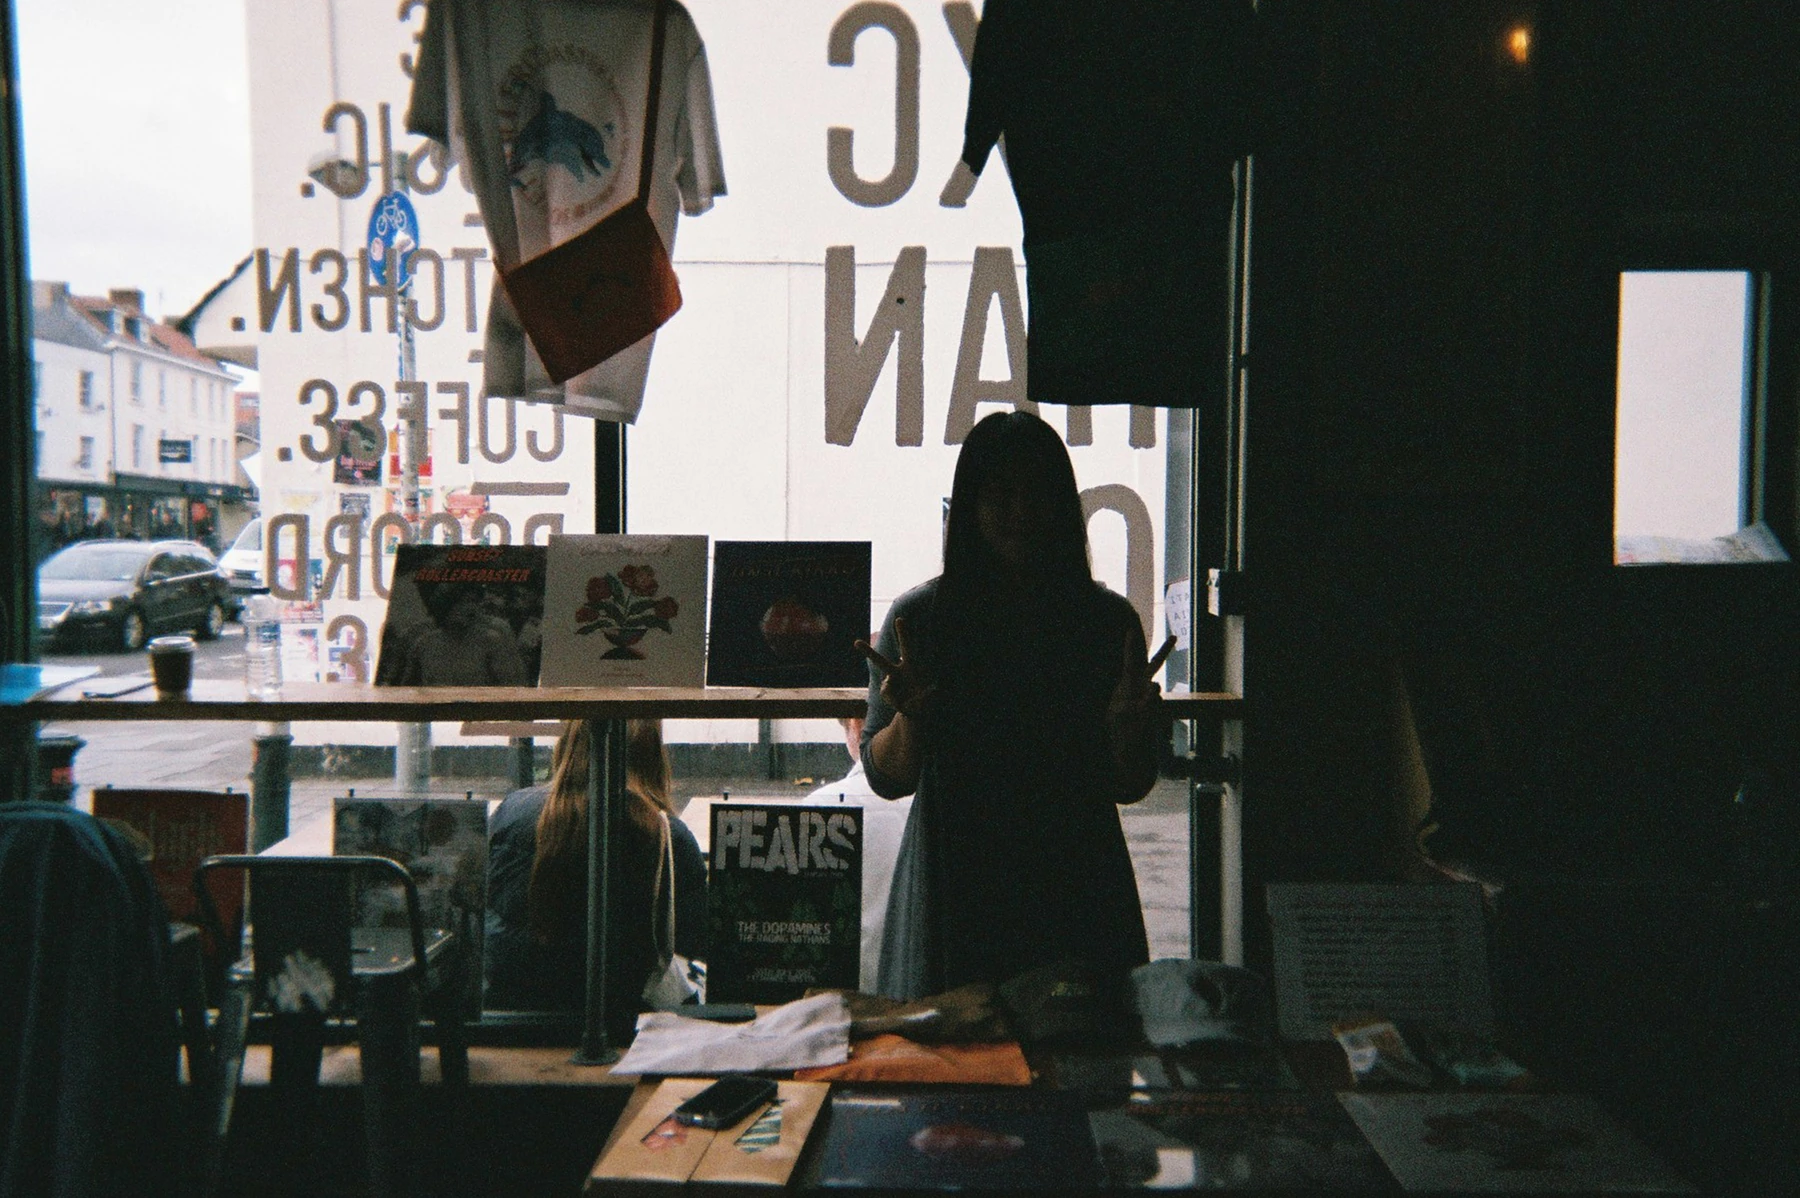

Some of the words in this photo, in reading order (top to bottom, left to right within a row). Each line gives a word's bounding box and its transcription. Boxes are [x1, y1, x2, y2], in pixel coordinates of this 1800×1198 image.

[446, 548, 506, 562] SUNSET
[414, 567, 532, 582] ROLLERCOASTER
[715, 810, 857, 875] PEARS
[738, 921, 758, 933] THE
[762, 921, 831, 936] DOPAMINES
